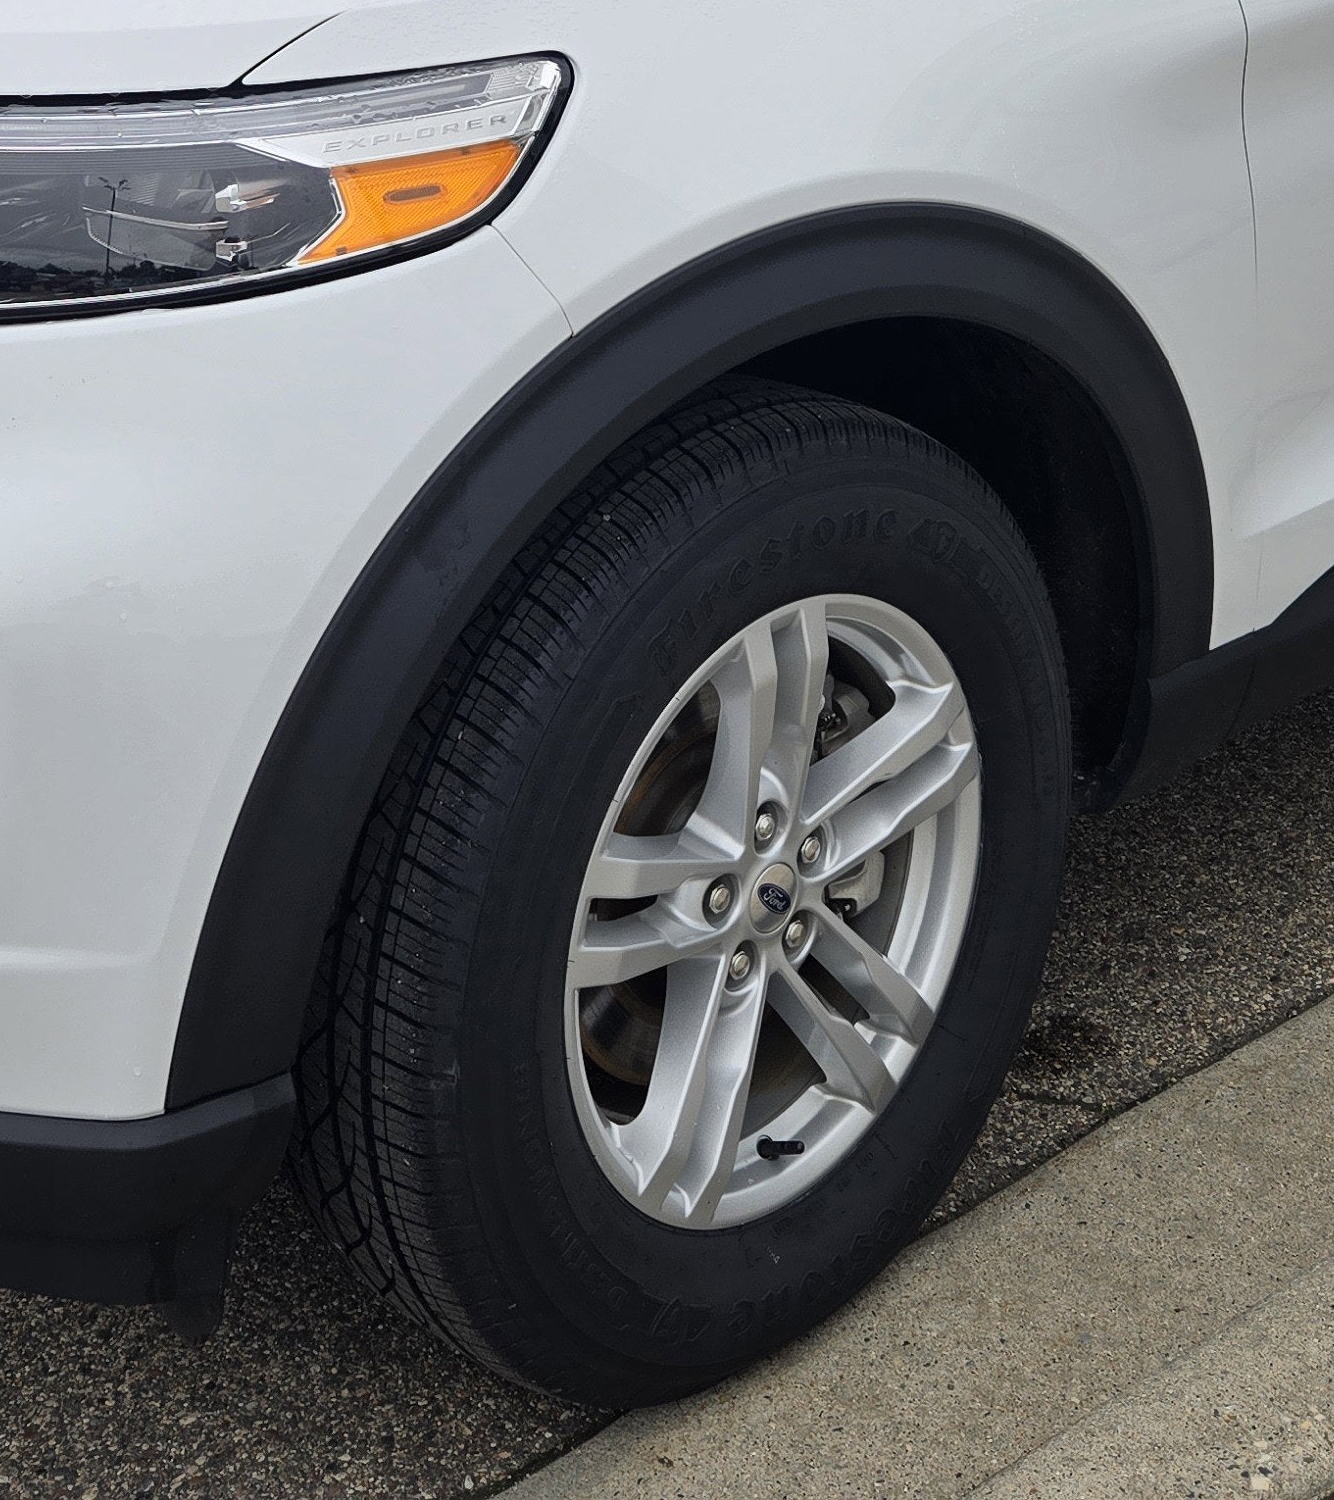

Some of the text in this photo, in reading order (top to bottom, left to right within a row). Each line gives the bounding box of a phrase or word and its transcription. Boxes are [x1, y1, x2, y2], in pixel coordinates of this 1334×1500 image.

[322, 114, 508, 153] EXPLORER
[646, 508, 899, 679] Firestone
[763, 887, 787, 911] Ford
